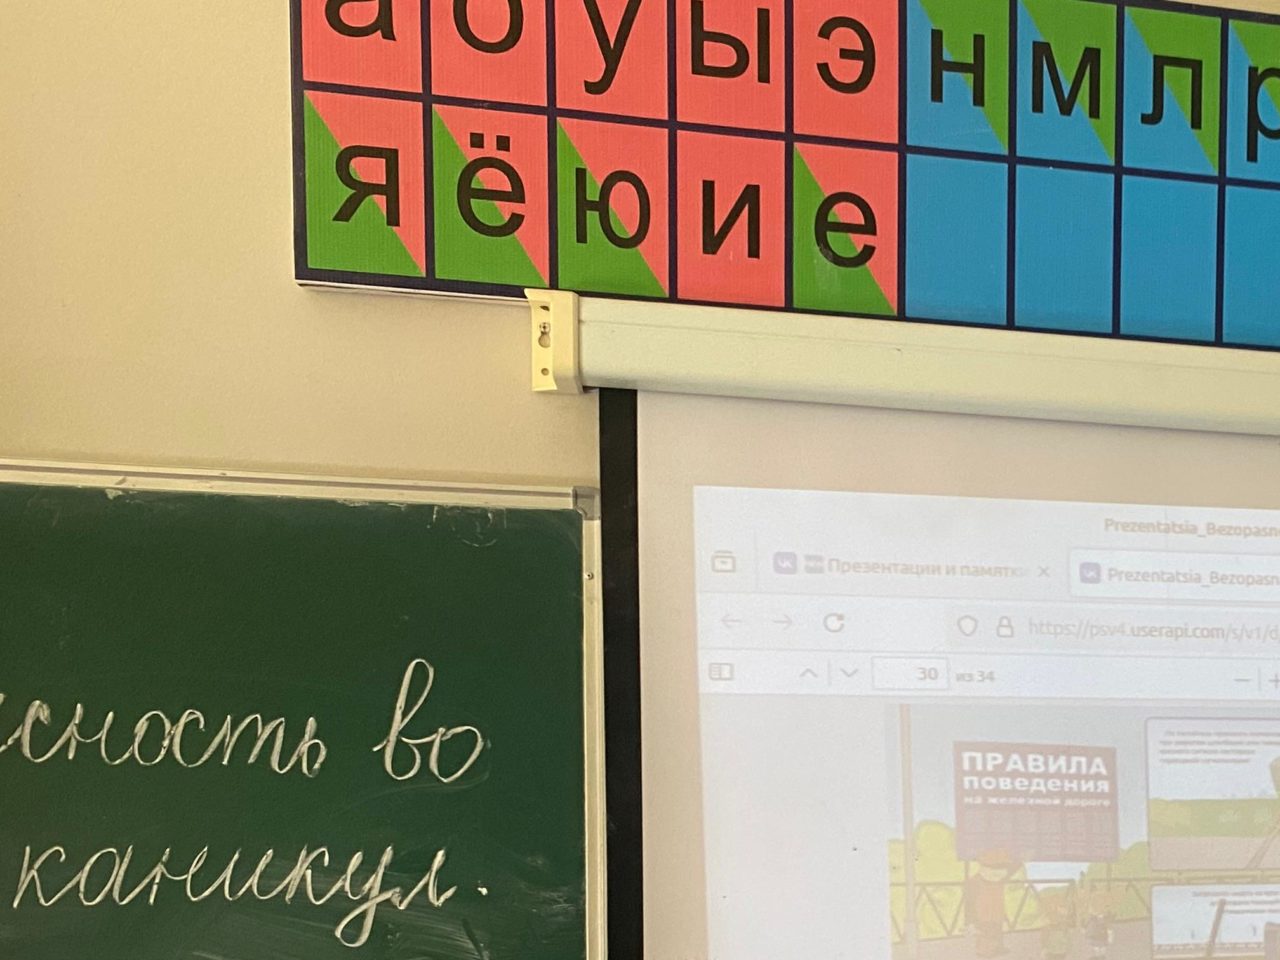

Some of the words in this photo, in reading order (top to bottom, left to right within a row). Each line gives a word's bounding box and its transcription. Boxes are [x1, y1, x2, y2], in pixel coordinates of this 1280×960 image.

[690, 0, 770, 84] ы
[816, 16, 876, 94] э
[930, 28, 986, 108] н
[1031, 40, 1102, 120] м
[1140, 53, 1204, 131] л
[331, 145, 400, 227] я
[456, 132, 526, 238] ё
[575, 166, 651, 250] ю
[702, 179, 760, 259] и
[813, 191, 877, 269] е
[827, 558, 942, 578] Презентации
[945, 564, 956, 576] и
[916, 667, 938, 682] 30
[976, 670, 995, 683] 34
[0, 692, 327, 778] сность
[373, 658, 486, 783] во
[962, 751, 1108, 776] ПРАВИЛА
[963, 776, 1110, 794] поведения
